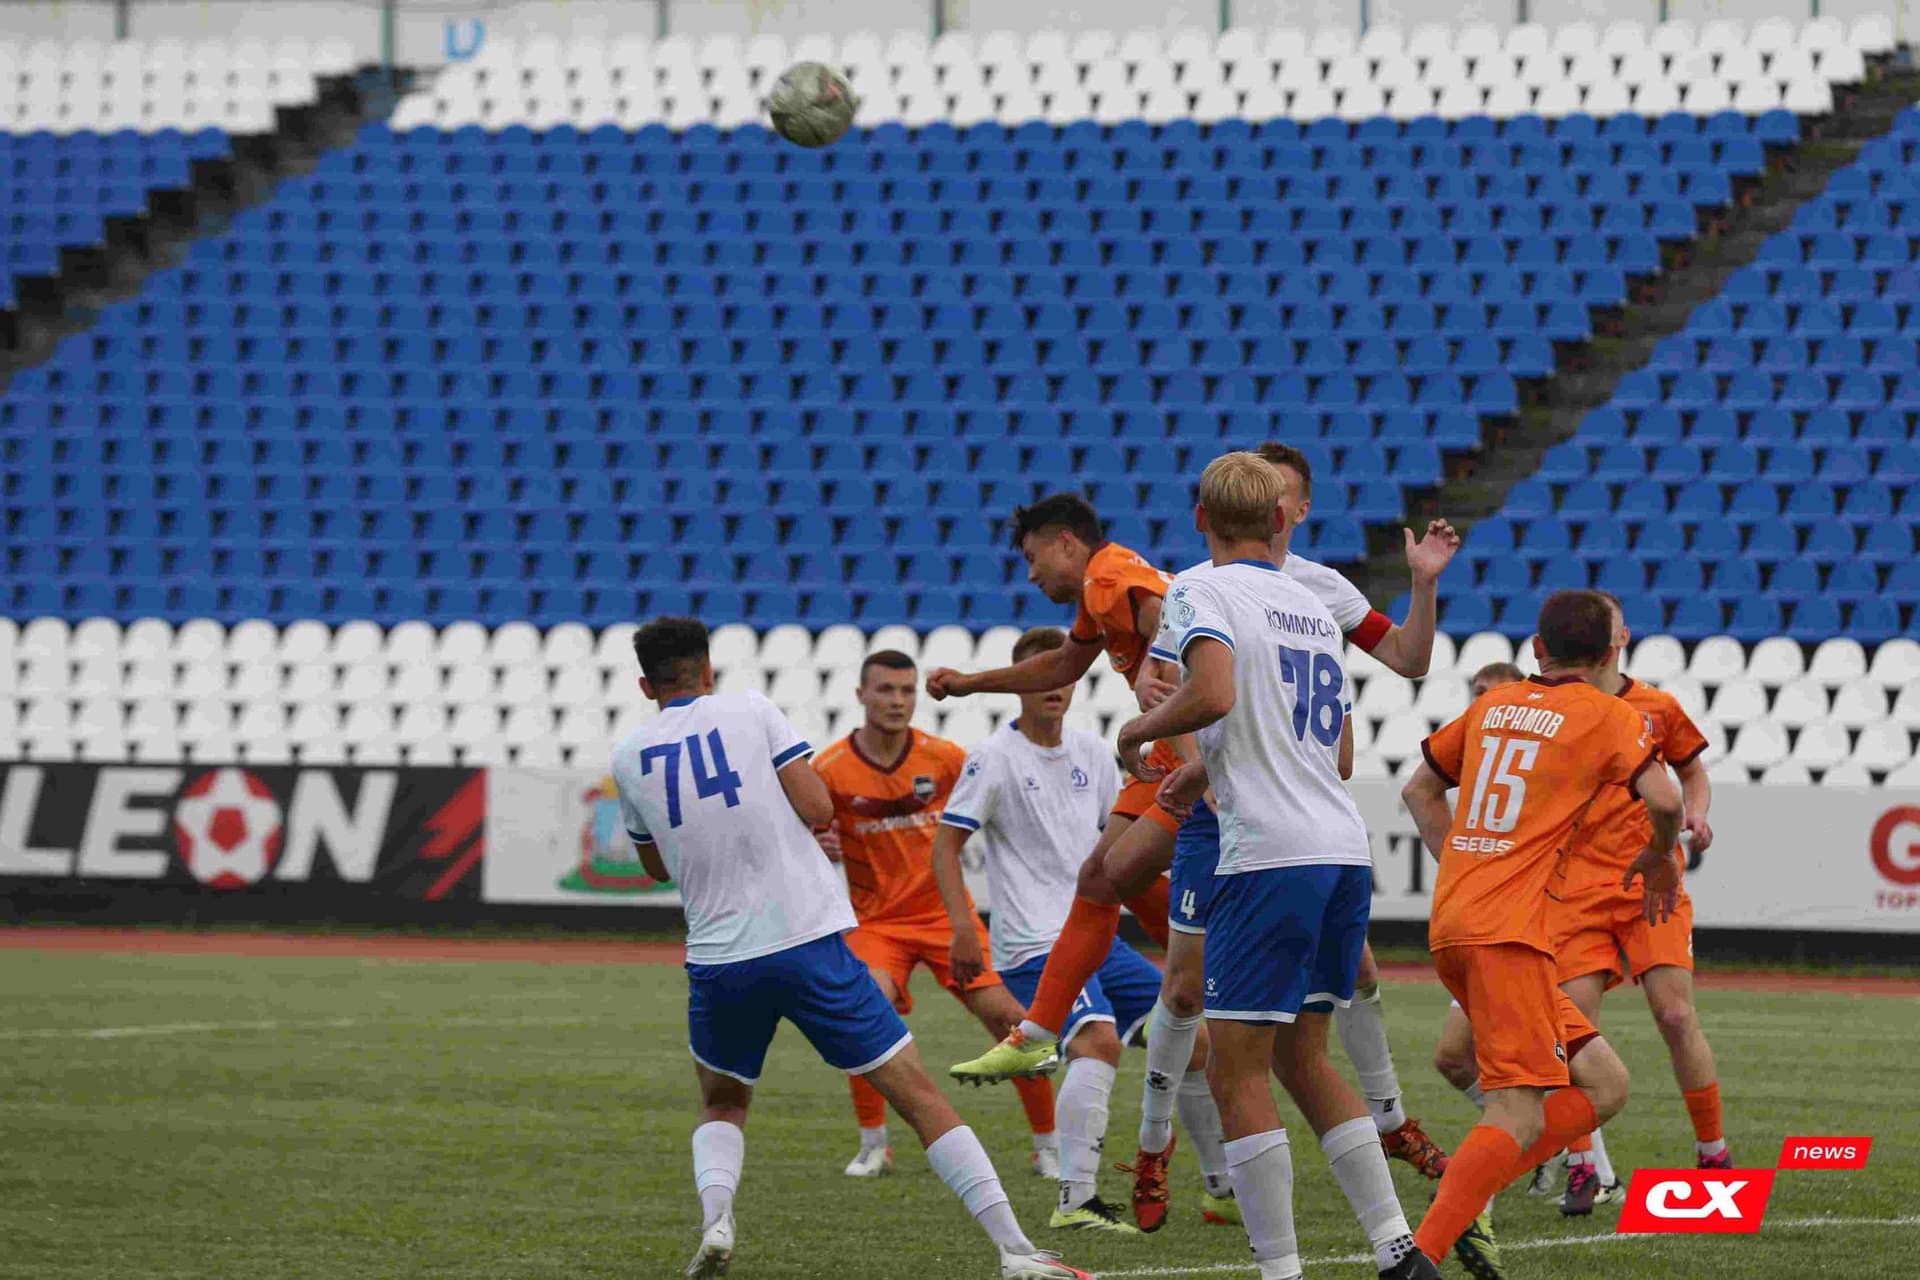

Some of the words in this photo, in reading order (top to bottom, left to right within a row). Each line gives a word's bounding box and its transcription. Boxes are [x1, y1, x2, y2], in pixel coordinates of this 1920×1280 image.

[1278, 644, 1343, 747] 78
[1481, 705, 1565, 738] АБРАМОВ
[639, 727, 743, 829] 74
[1465, 735, 1541, 833] 15
[1180, 889, 1196, 921] 4
